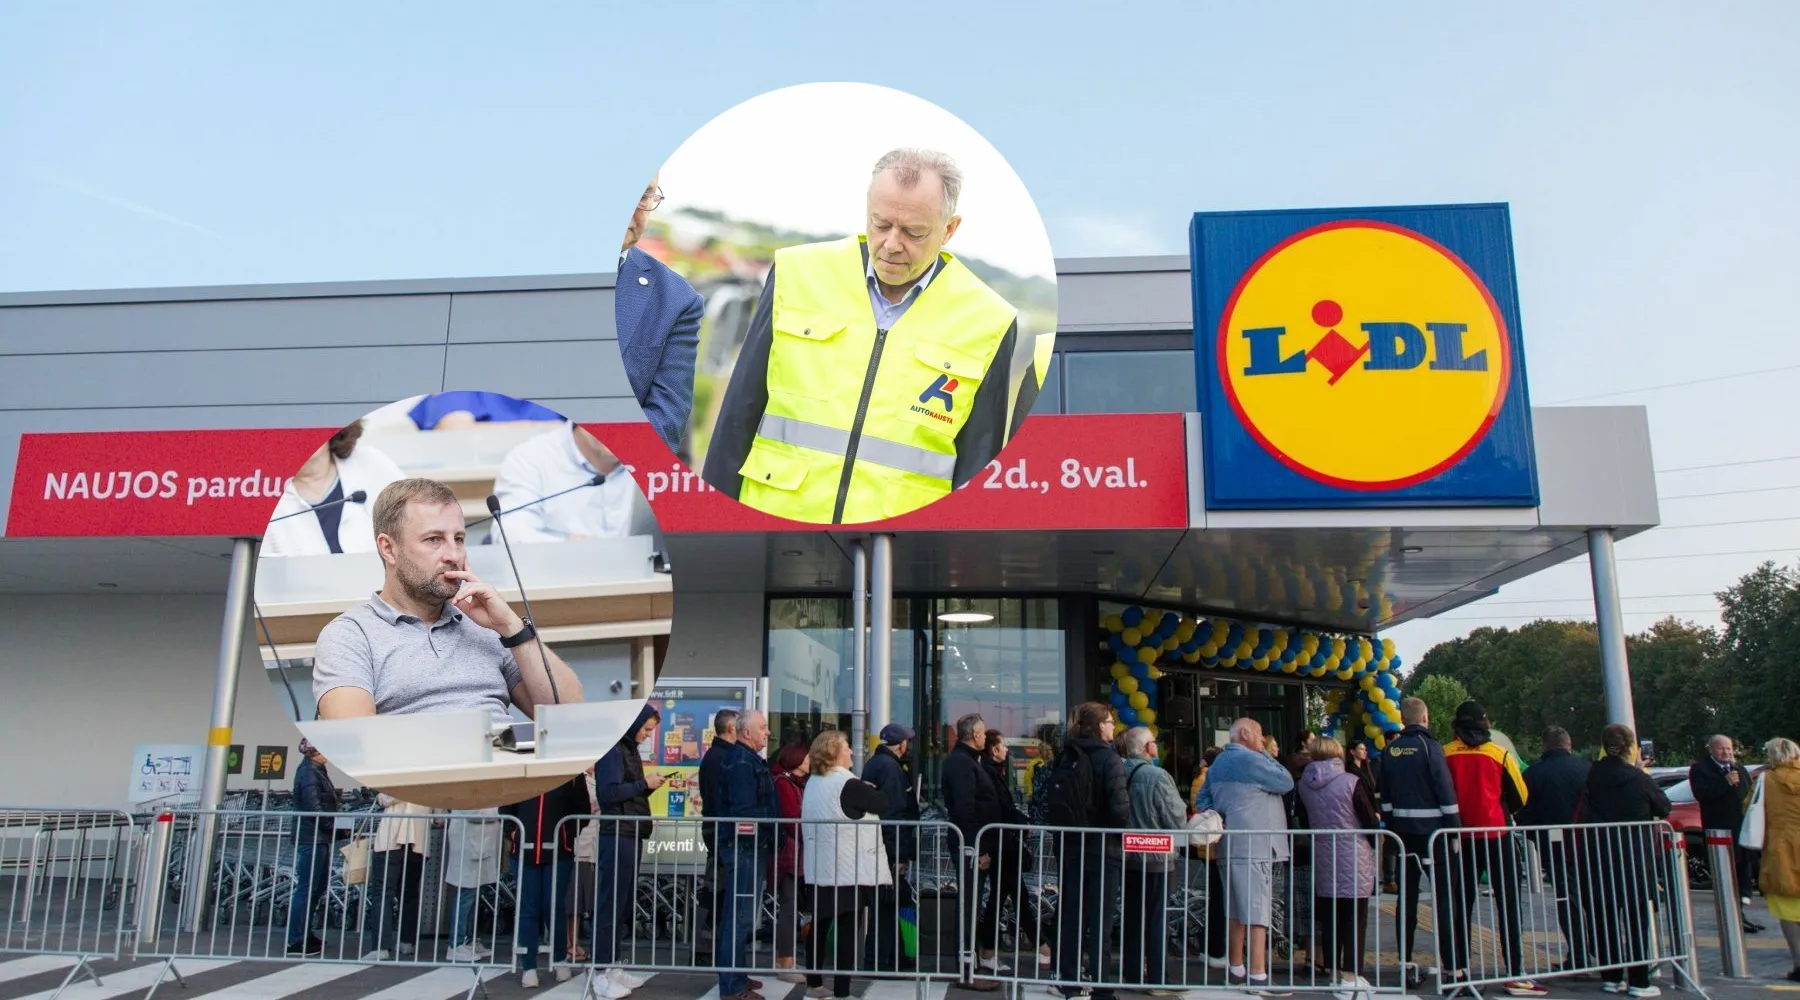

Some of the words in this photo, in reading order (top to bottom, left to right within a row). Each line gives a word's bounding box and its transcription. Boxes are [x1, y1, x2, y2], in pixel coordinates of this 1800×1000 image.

[910, 404, 953, 424] AUTOKAUSTA
[43, 470, 179, 500] NAUJOS
[1060, 457, 1148, 488] 8val.
[647, 838, 694, 854] gyventi
[1125, 836, 1169, 846] STORENT
